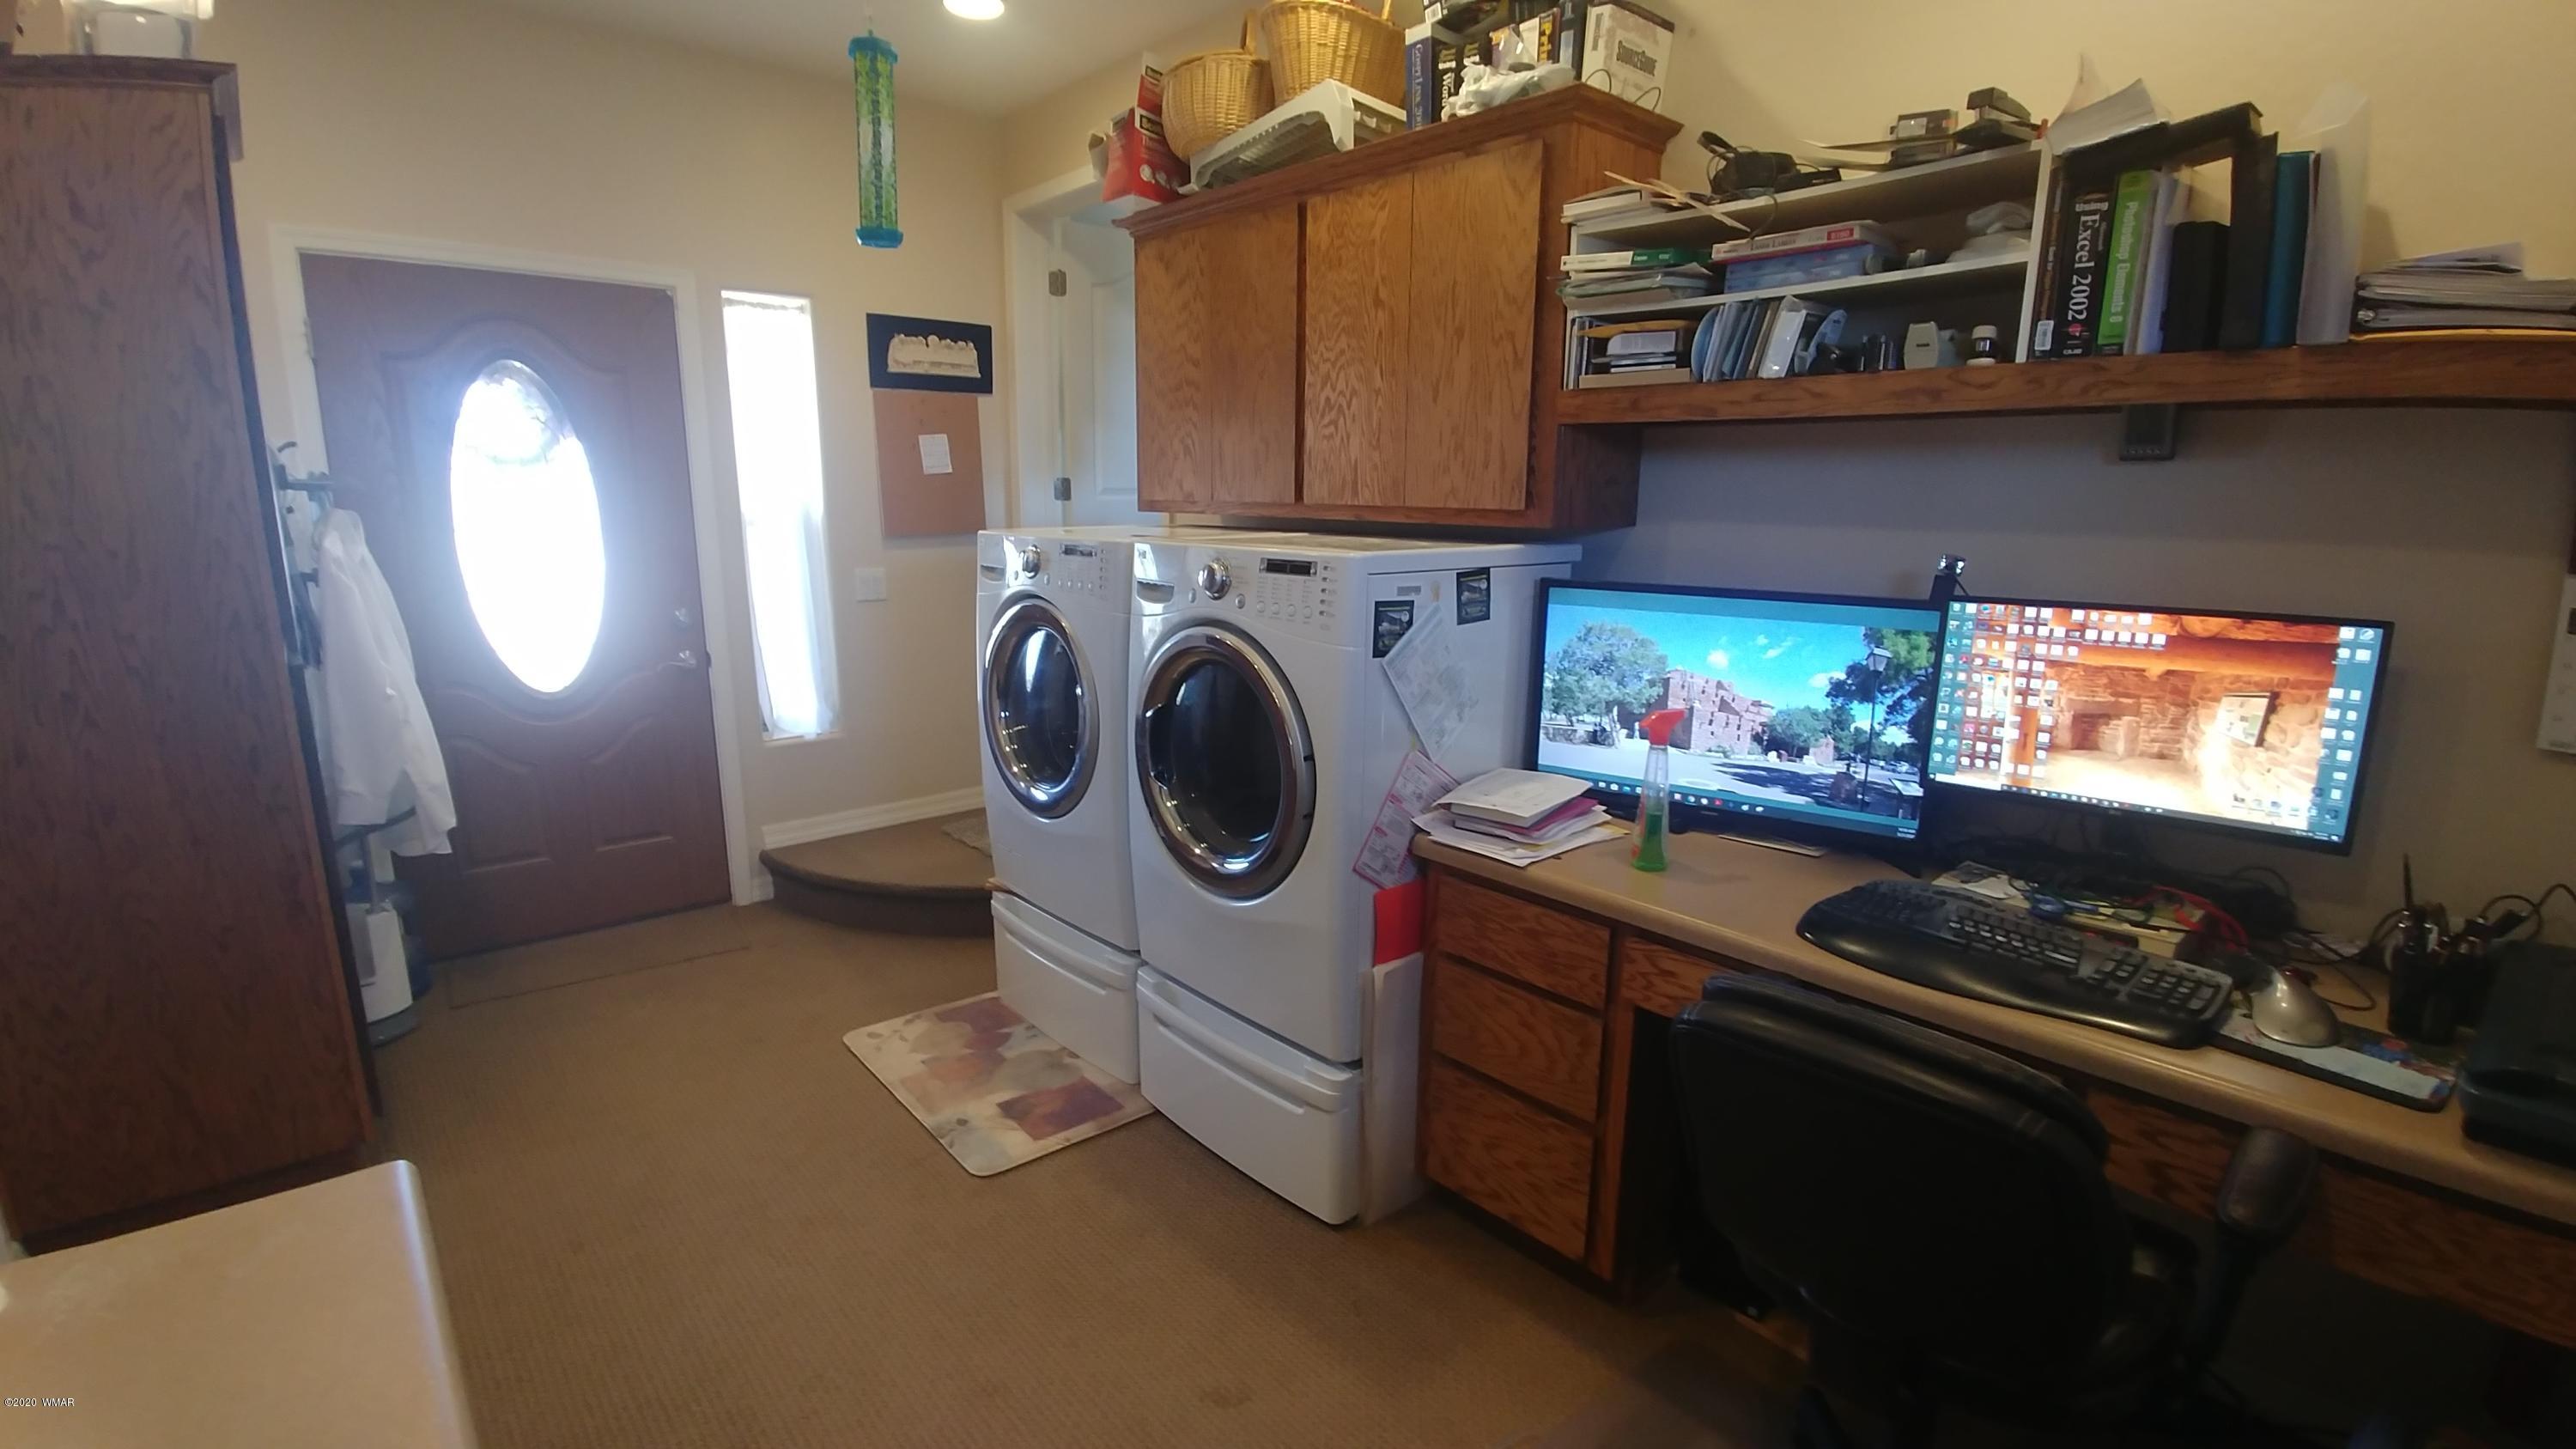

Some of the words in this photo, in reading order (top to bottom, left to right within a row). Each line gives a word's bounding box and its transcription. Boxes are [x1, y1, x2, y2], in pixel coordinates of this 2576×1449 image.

[2074, 212, 2101, 269] Excel
[2116, 201, 2139, 260] Photoshop
[2067, 274, 2092, 321] 2002
